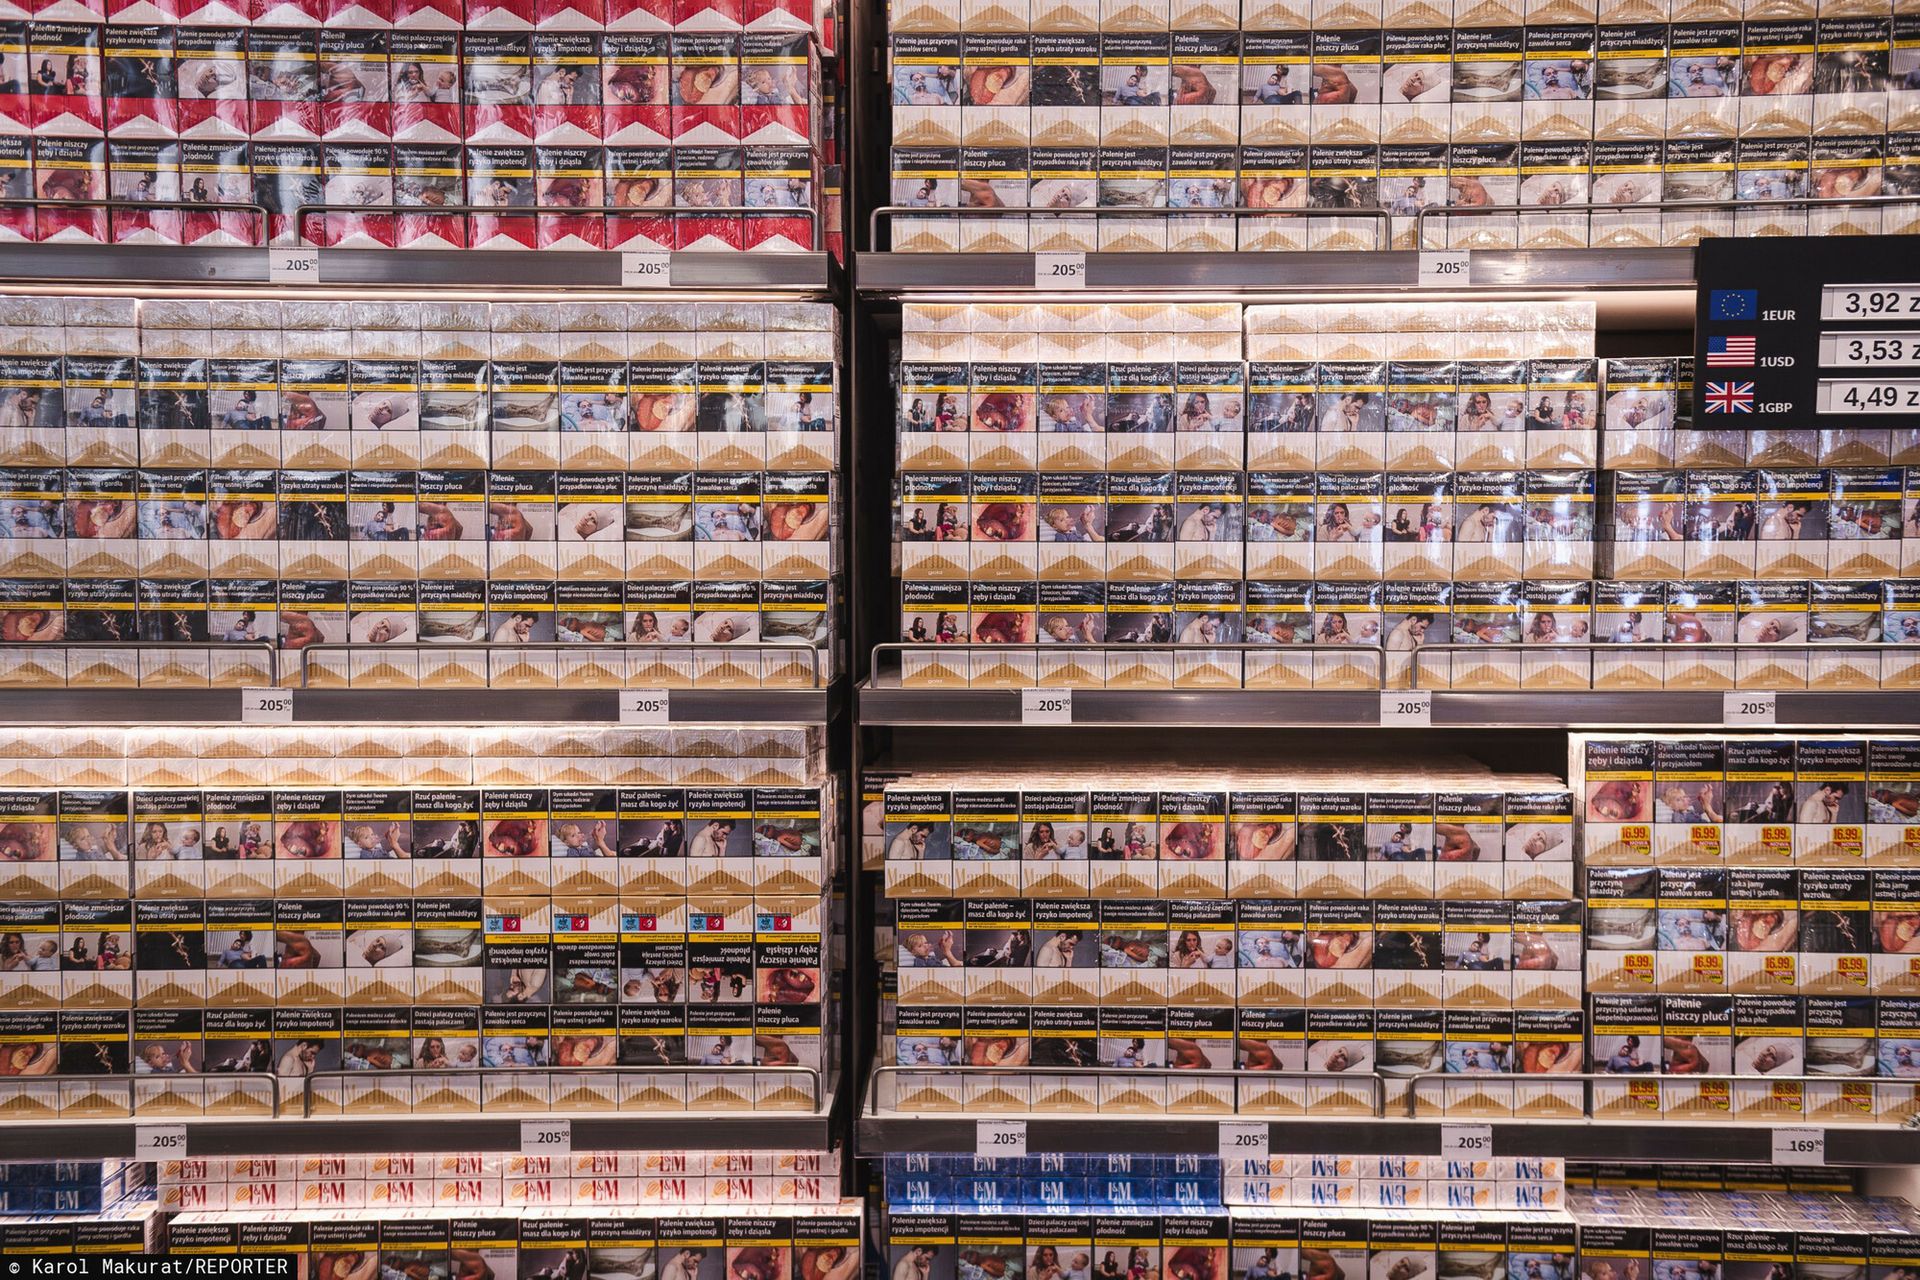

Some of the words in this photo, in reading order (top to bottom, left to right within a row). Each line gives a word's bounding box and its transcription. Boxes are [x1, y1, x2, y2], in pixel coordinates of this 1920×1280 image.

[560, 36, 590, 44] zwiększa
[629, 36, 652, 44] niszczy
[918, 38, 928, 46] jest
[535, 45, 556, 53] ryzyko
[557, 45, 592, 53] impotencji
[1316, 44, 1339, 52] niszczy
[209, 144, 242, 153] zmniejsza
[287, 260, 309, 270] 205
[638, 263, 660, 274] 205
[1052, 265, 1075, 275] 205
[1436, 263, 1460, 273] 205
[1845, 293, 1899, 317] 3,92
[1762, 310, 1795, 320] 1EUR
[1849, 341, 1902, 364] 3,53
[1760, 357, 1794, 367] 1USD
[1844, 387, 1897, 410] 4,49
[1759, 403, 1793, 413] 1GBP
[930, 584, 961, 592] zmniejsza
[260, 700, 283, 710] 205
[637, 701, 659, 711] 205
[1039, 701, 1062, 711] 205
[1398, 703, 1421, 713] 205
[1741, 703, 1765, 714] 205
[1589, 746, 1618, 754] Palenie
[1620, 745, 1649, 756] niszczy
[1659, 744, 1673, 752] Dym
[1827, 747, 1860, 755] zwiększa
[1589, 757, 1607, 766] zęby
[1800, 756, 1823, 764] ryzyko
[1825, 756, 1863, 764] impotencji
[302, 794, 325, 802] niszczy
[637, 792, 661, 800] palenie
[714, 792, 743, 800] zwiększa
[277, 803, 292, 811] zęby
[650, 801, 666, 809] kogo
[668, 801, 678, 809] żyć
[1622, 827, 1645, 838] 16.99
[1692, 828, 1715, 839] 16.99
[1763, 828, 1786, 839] 16.99
[1834, 829, 1857, 839] 16.99
[1757, 872, 1790, 880] powoduje
[1832, 873, 1865, 881] zwiększa
[1804, 882, 1827, 891] ryzyko
[1829, 882, 1851, 891] utraty
[1625, 956, 1649, 967] 16.99
[1695, 957, 1717, 967] 16.99
[1767, 957, 1790, 968] 16.99
[1666, 999, 1701, 1008] Palenie
[1666, 1012, 1699, 1023] niszczy
[1703, 1012, 1728, 1023] płuca
[153, 1136, 177, 1147] 205
[538, 1132, 561, 1143] 205
[993, 1133, 1017, 1144] 205
[1236, 1135, 1259, 1145] 205
[1459, 1138, 1482, 1148] 205
[1790, 1141, 1814, 1151] 169
[198, 1227, 229, 1235] zwiększa
[172, 1236, 194, 1244] ryzyko
[196, 1235, 231, 1243] impotencji
